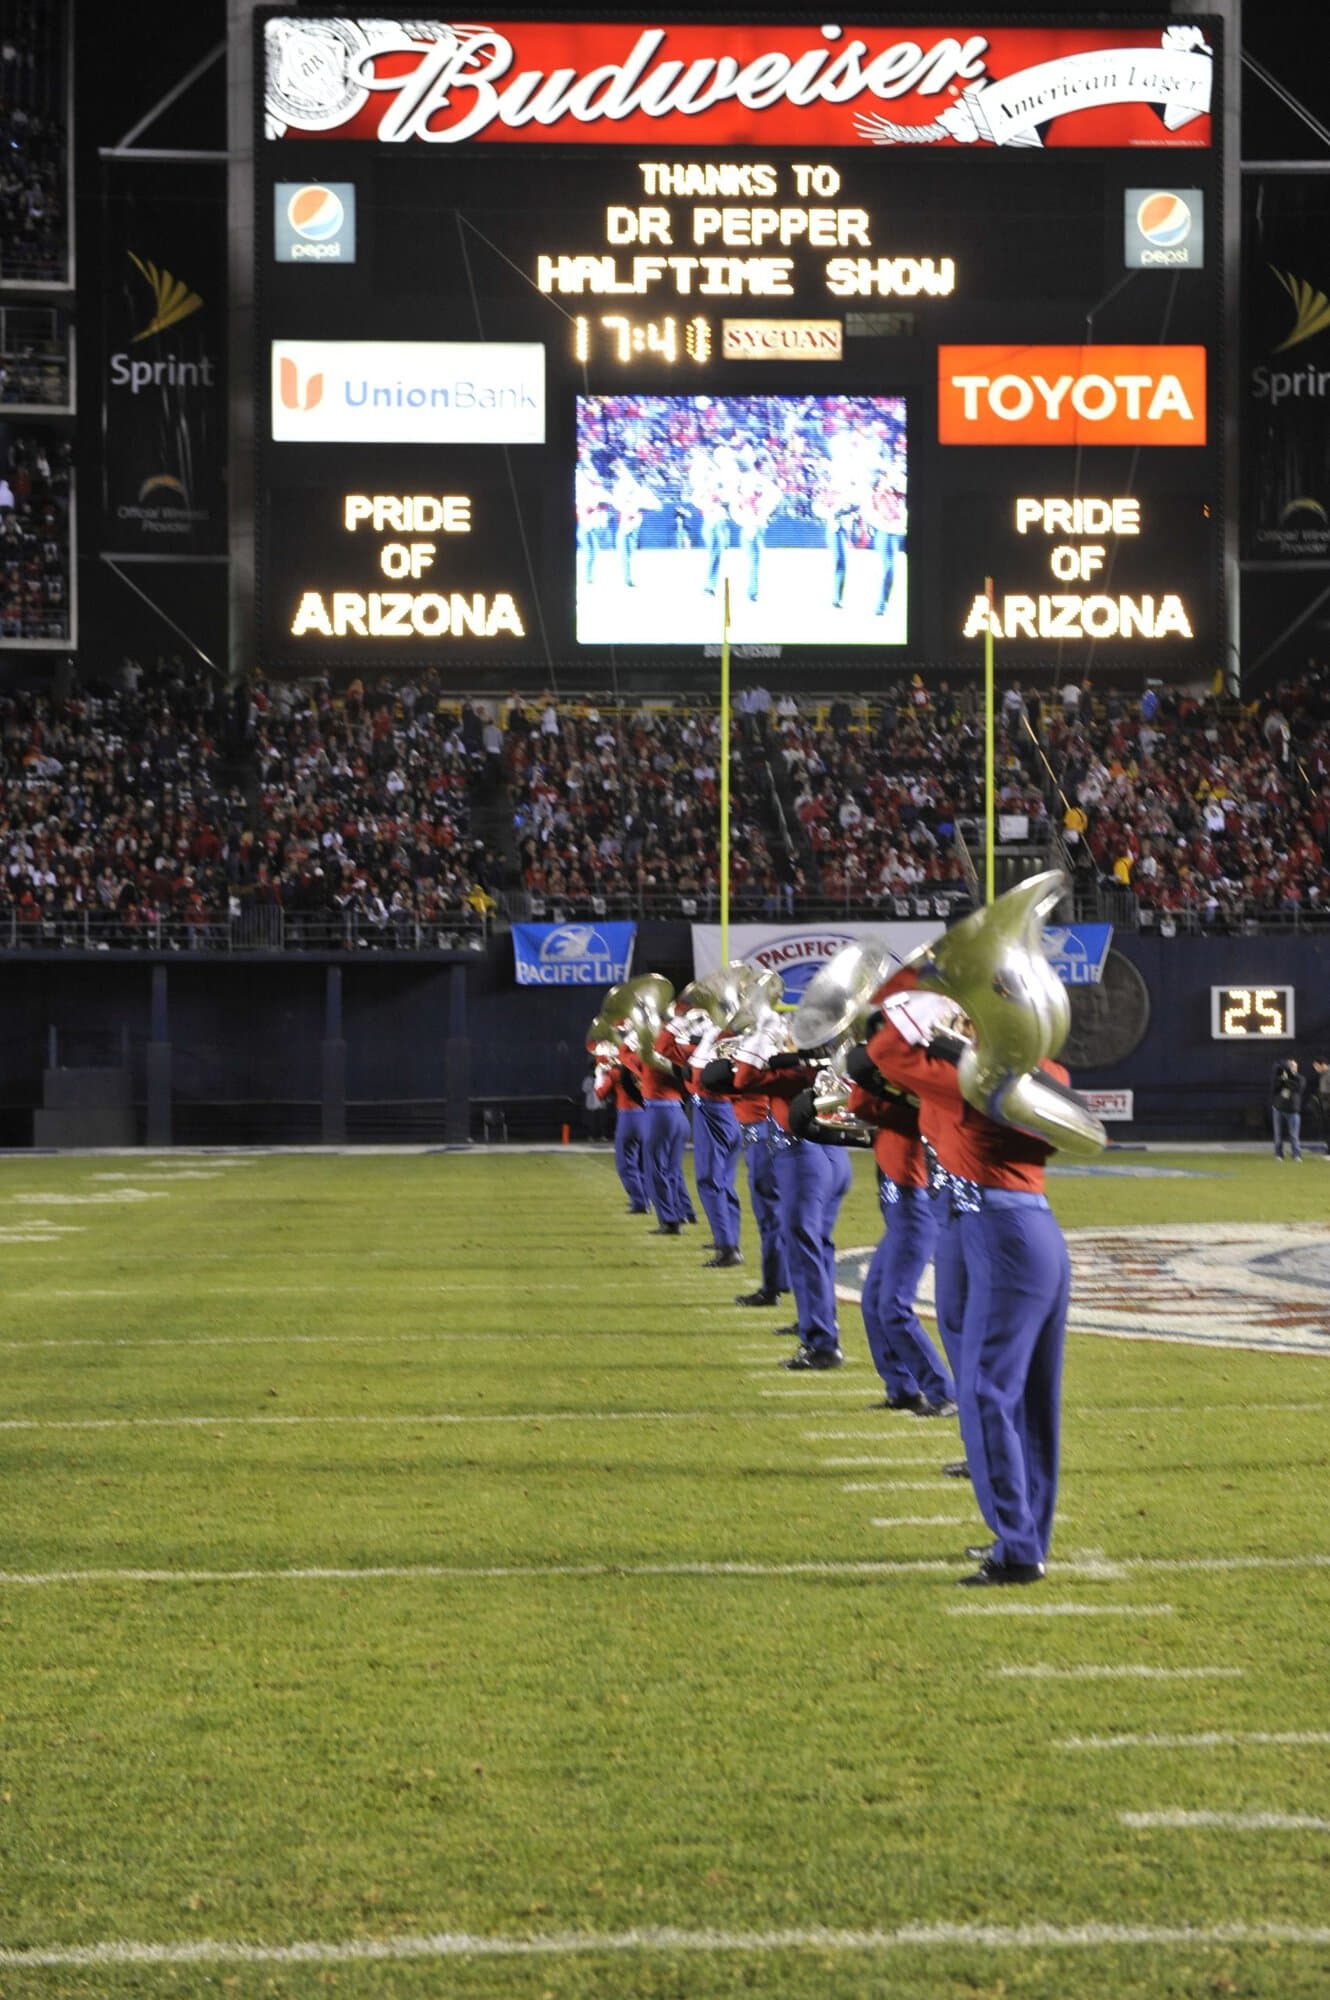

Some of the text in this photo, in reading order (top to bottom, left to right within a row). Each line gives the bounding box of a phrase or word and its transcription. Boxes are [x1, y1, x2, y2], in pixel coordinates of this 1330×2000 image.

[348, 26, 989, 143] Budweiser
[999, 70, 1118, 124] American
[639, 163, 841, 197] THANKS TO
[606, 206, 871, 247] DR PEPPER
[290, 243, 342, 260] pepsi
[1140, 248, 1190, 265] pepsi
[537, 256, 956, 297] HALFTIME SHOW
[726, 328, 839, 351] SYCUAN
[110, 352, 214, 394] Sprint
[344, 380, 537, 409] UnionBank
[951, 374, 1194, 420] TOYOTA
[344, 495, 472, 533] PRIDE
[1015, 498, 1141, 535] PRIDE
[380, 542, 437, 579] OF
[1051, 544, 1106, 581] OF
[290, 591, 526, 637] ARIZONA
[962, 594, 1194, 639] ARIZONA
[516, 961, 626, 984] PACIFIC LIF
[756, 941, 837, 970] PACIFIC
[1223, 989, 1283, 1036] 25
